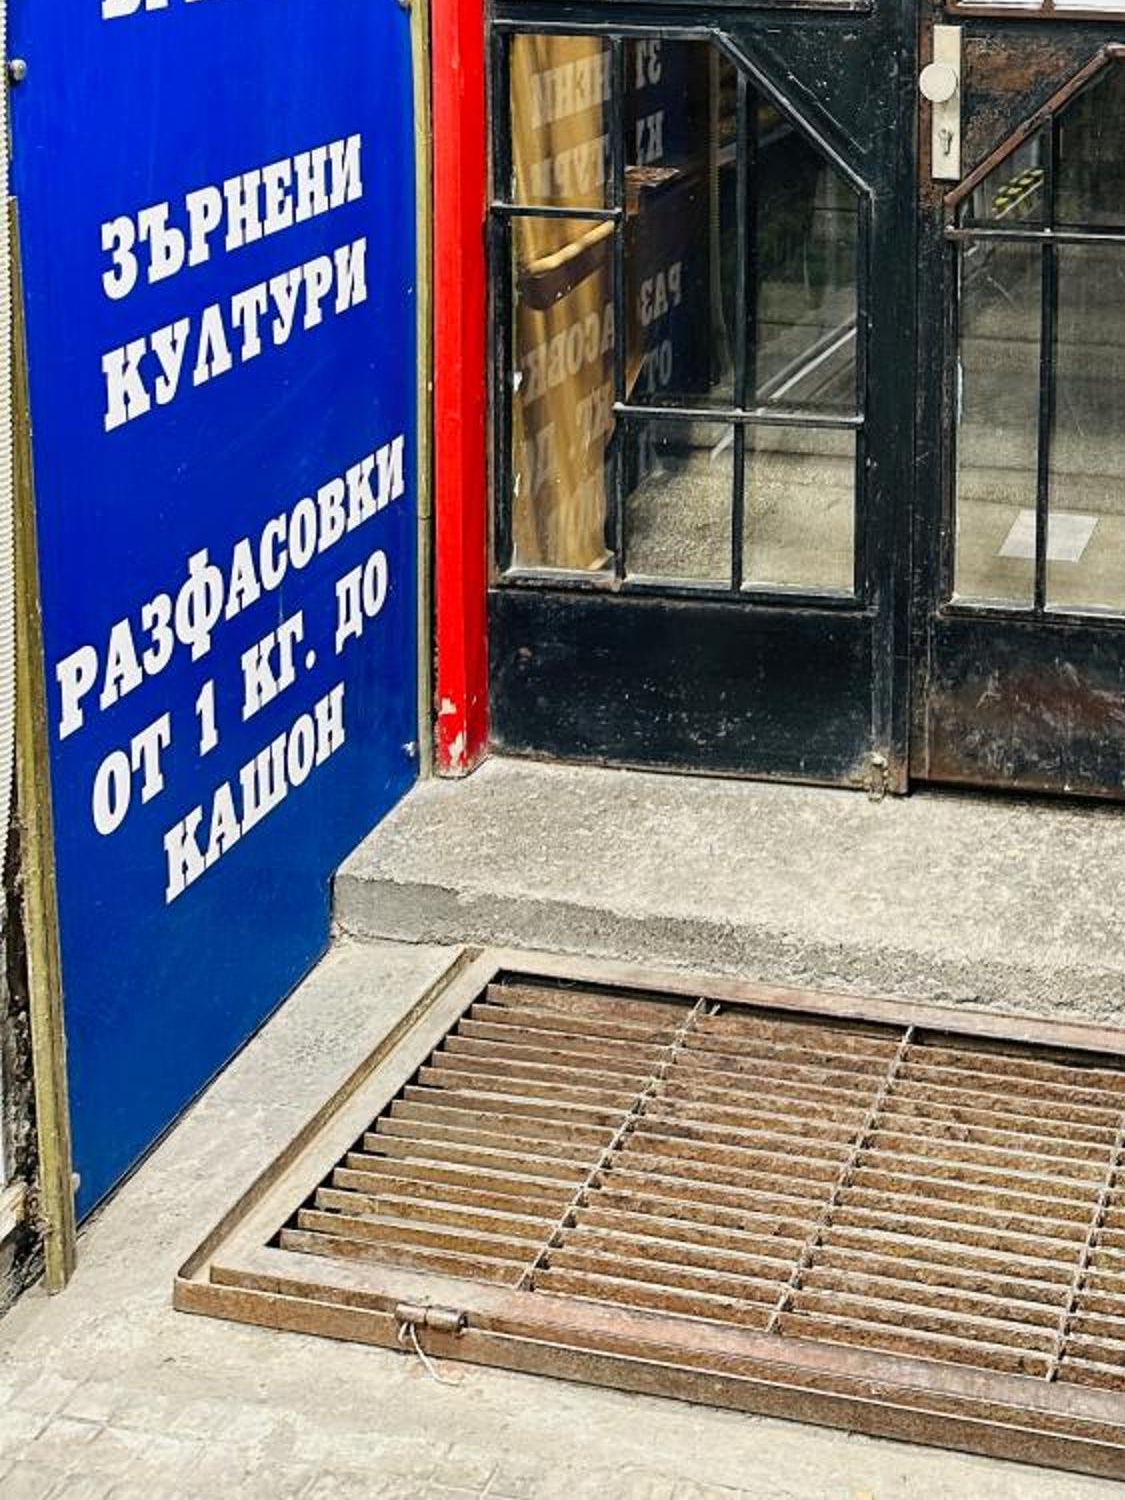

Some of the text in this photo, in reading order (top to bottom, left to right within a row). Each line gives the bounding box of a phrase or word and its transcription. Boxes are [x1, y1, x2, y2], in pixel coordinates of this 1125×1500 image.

[101, 133, 363, 300] ЗЪРНЕНИ
[101, 237, 367, 432] КУЛТУРИ
[56, 434, 405, 741] РАЗФАСОВКИ
[92, 549, 389, 837] ОТ 1 КГ. ДО
[163, 682, 346, 904] КАШОН
